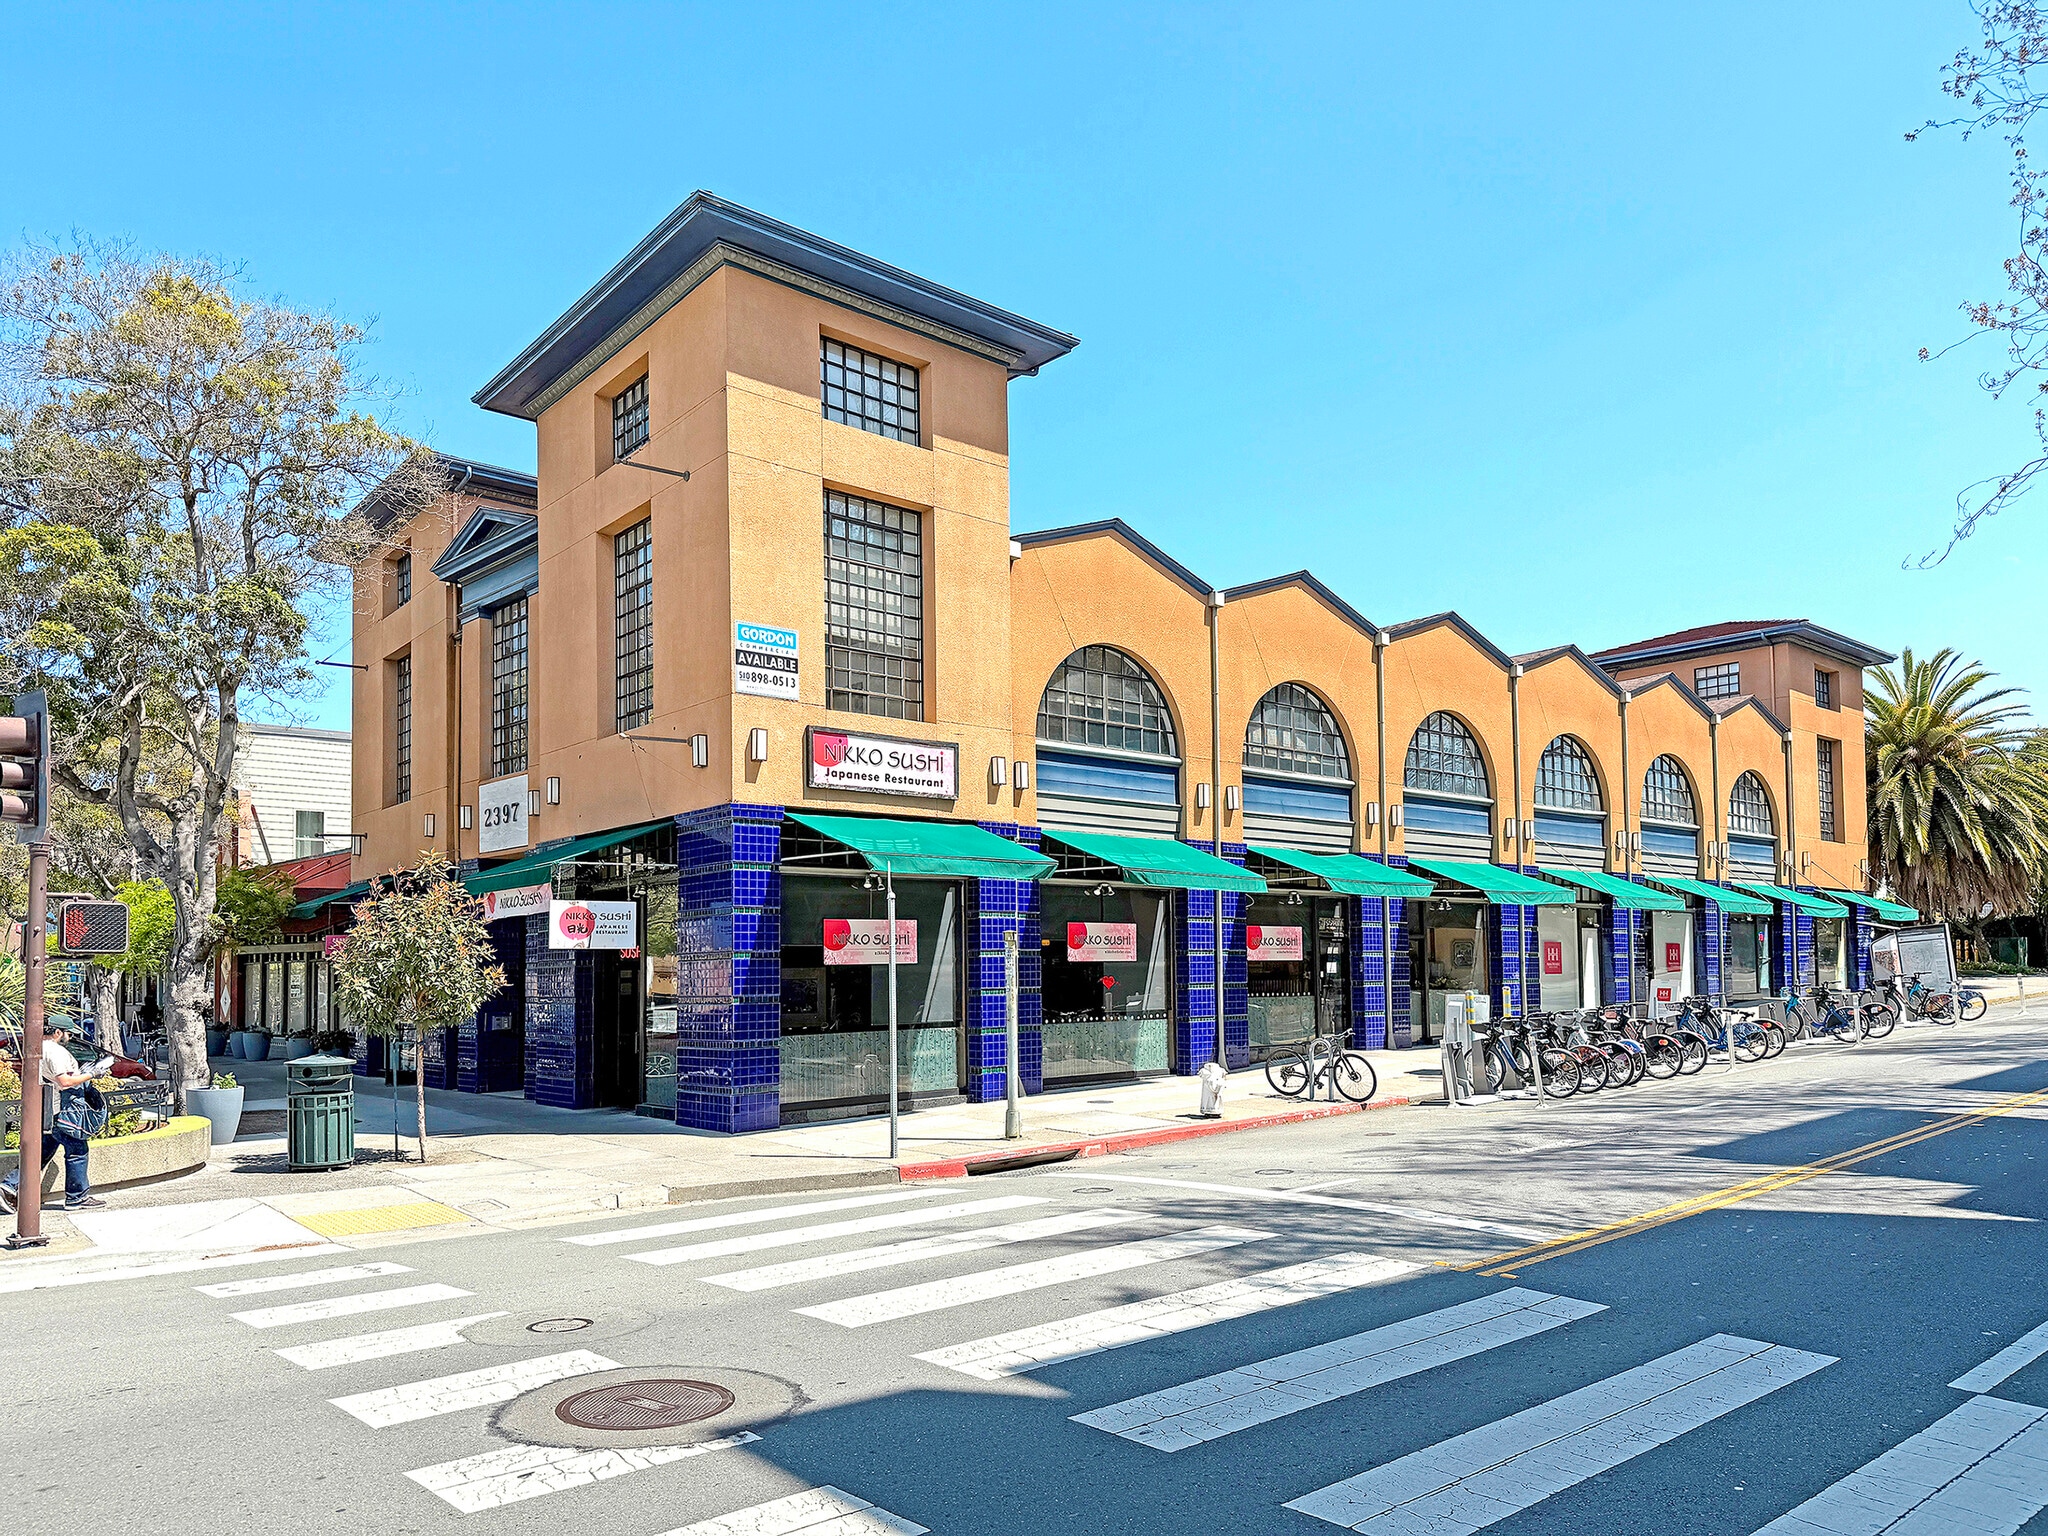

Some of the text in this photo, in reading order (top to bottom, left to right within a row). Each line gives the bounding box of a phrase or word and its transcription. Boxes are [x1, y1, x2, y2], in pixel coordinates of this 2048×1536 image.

[740, 626, 794, 647] GORDON
[740, 642, 794, 656] COMMERCIAL
[738, 652, 797, 672] AVAILABLE
[825, 767, 944, 788] Japanese Restaurant
[484, 802, 520, 828] 2397
[567, 922, 588, 934] 日光
